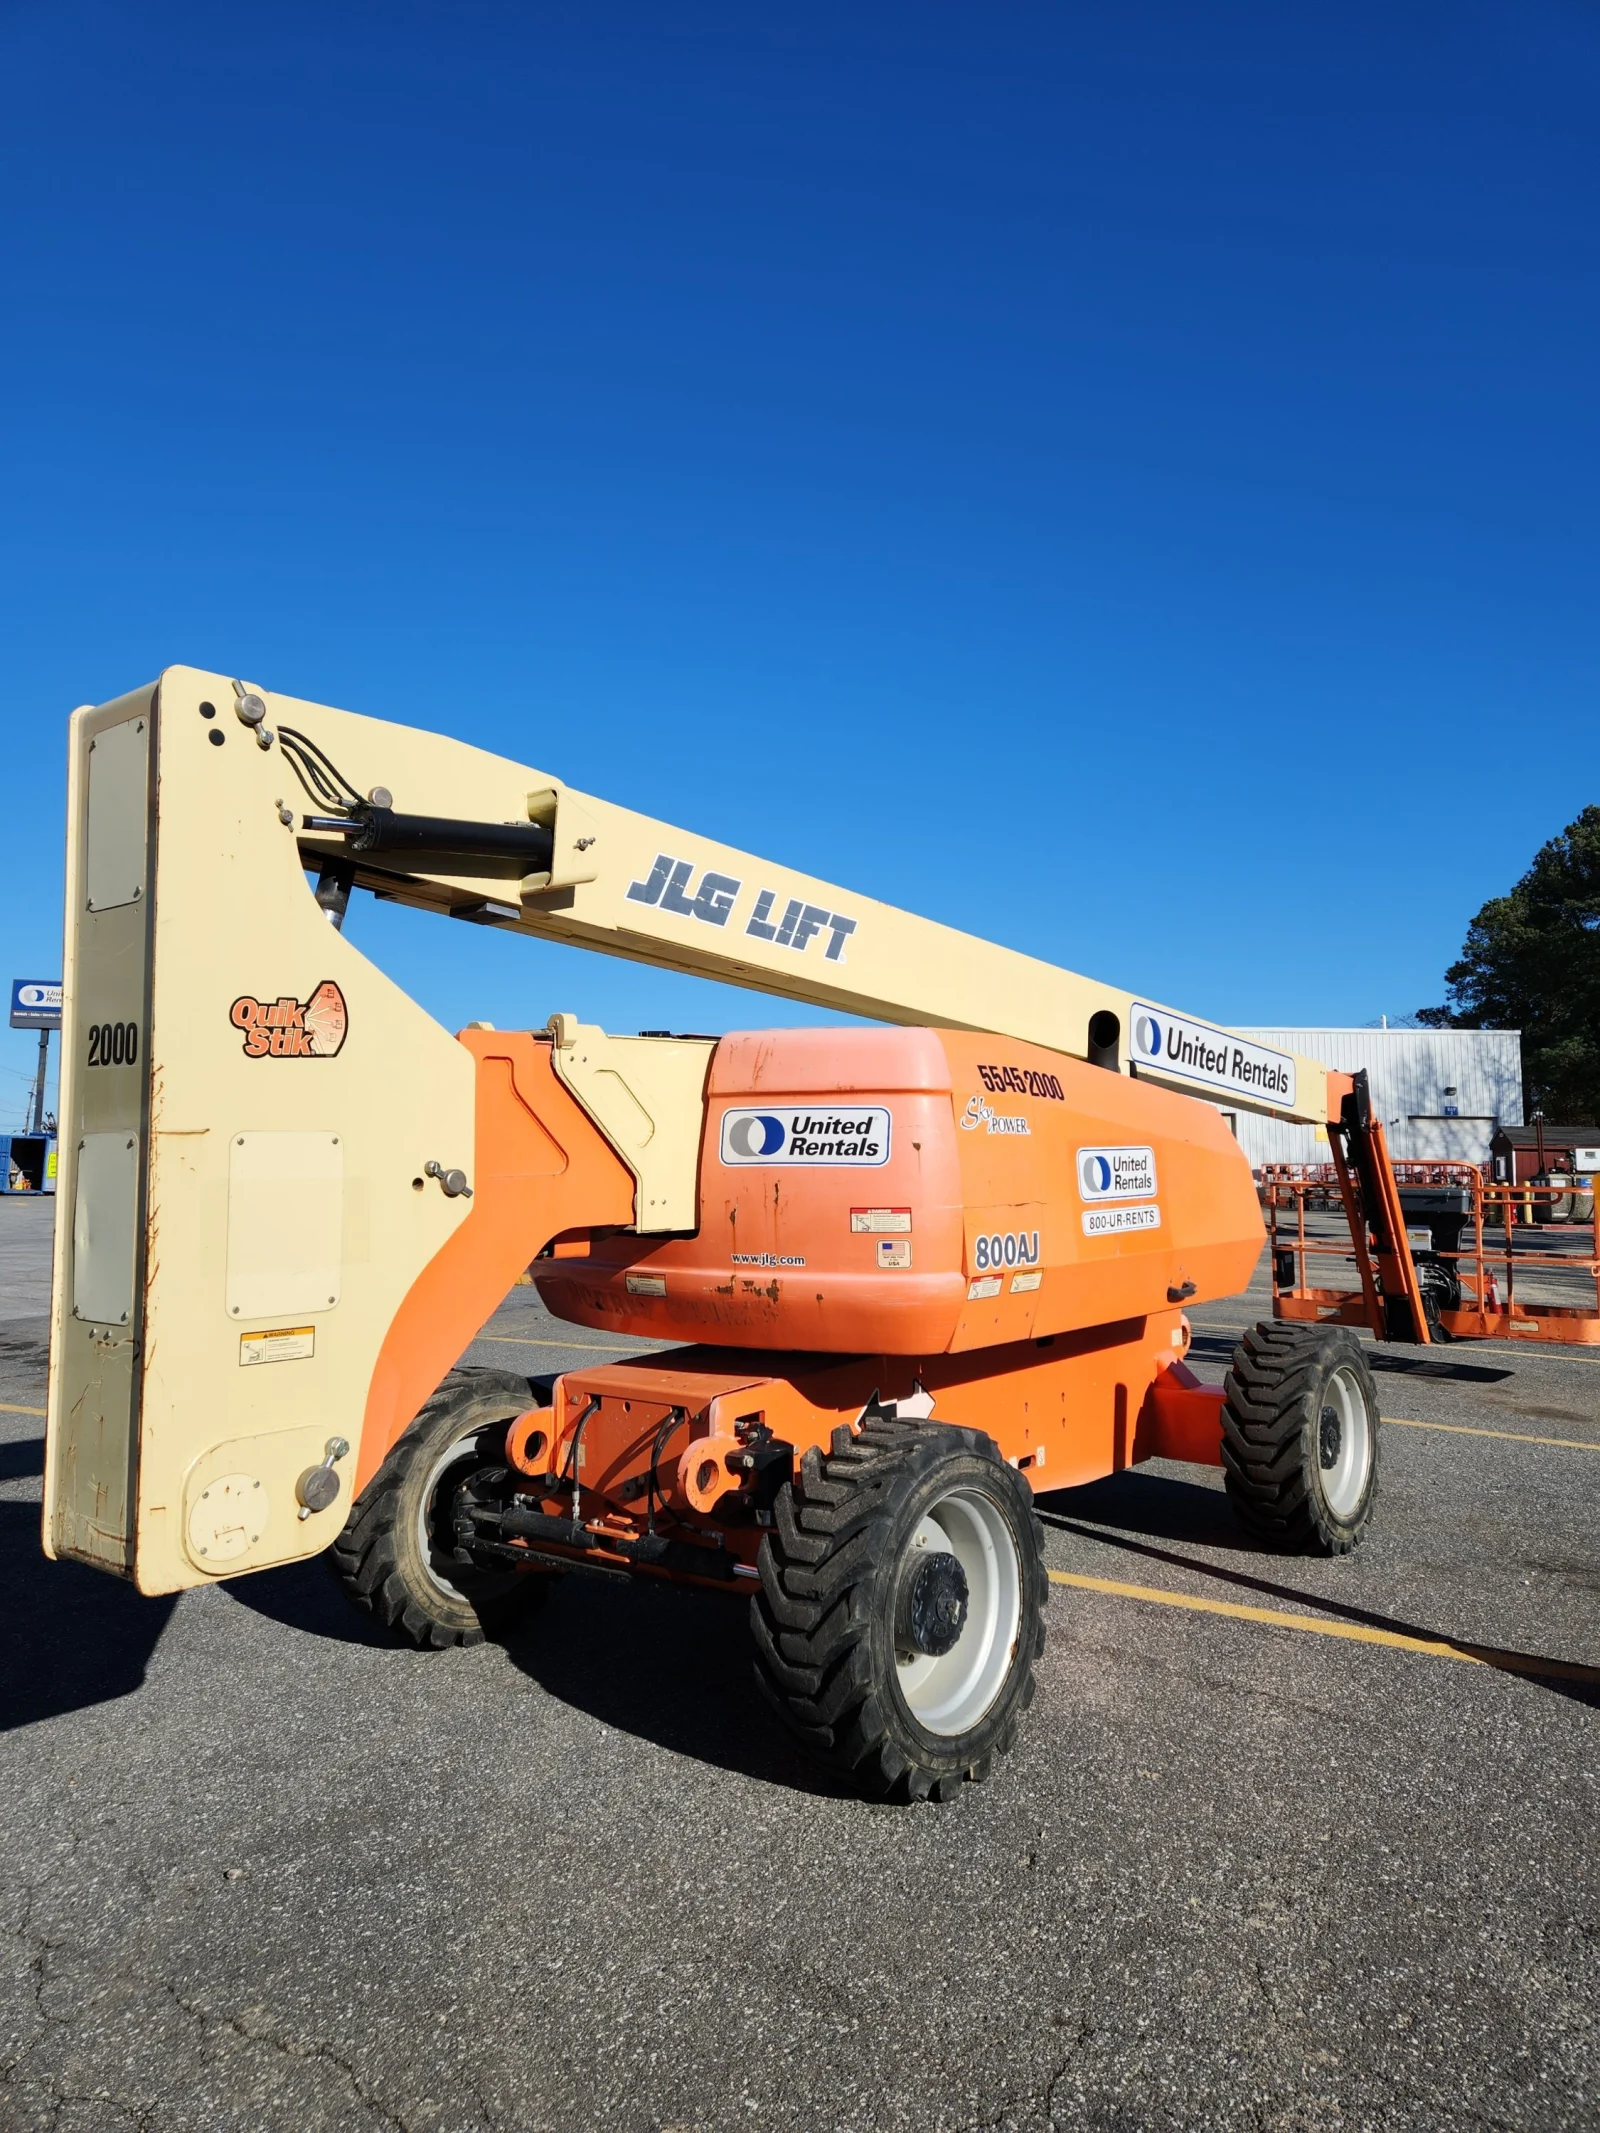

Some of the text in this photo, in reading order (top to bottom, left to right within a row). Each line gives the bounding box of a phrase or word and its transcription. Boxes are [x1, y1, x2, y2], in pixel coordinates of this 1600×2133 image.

[625, 853, 858, 962] JLG LIFT
[231, 998, 307, 1031] Quik
[88, 1022, 138, 1067] 2000
[245, 1027, 313, 1056] Stik
[1167, 1027, 1289, 1094] United Rentals
[791, 1116, 874, 1135] United
[789, 1137, 880, 1157] Rentals
[1113, 1155, 1148, 1172] United
[1114, 1173, 1152, 1191] Rentals
[1089, 1210, 1155, 1230] 800-UR-RENTS
[731, 1252, 806, 1268] www.jlg.com
[976, 1232, 1038, 1269] 800AJ
[268, 1330, 296, 1339] WARNING
